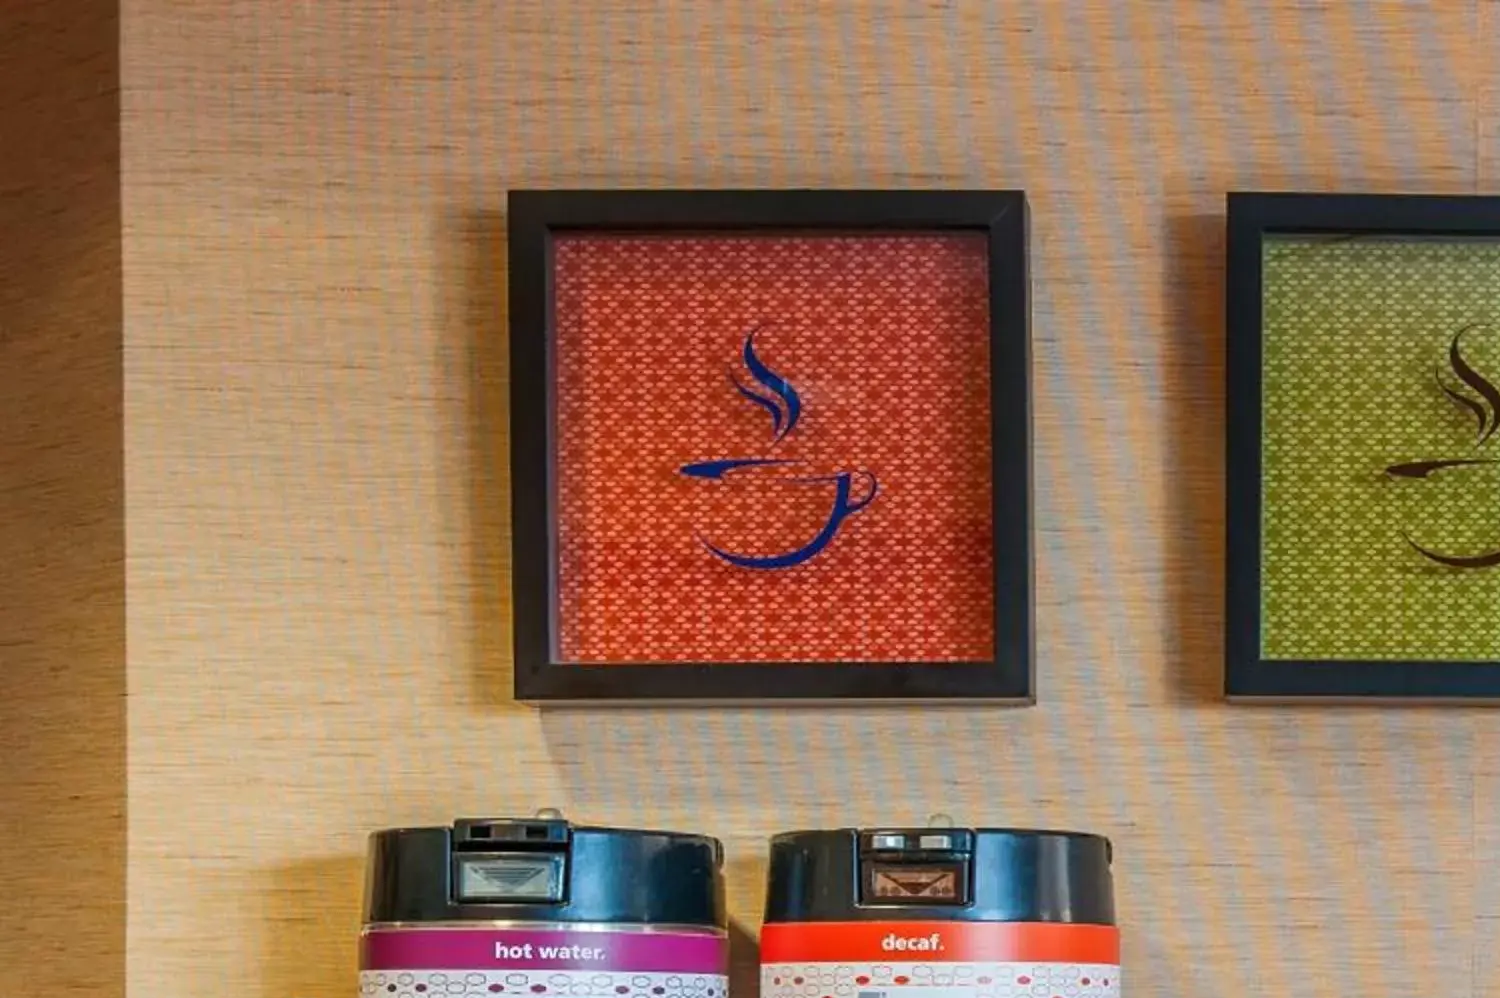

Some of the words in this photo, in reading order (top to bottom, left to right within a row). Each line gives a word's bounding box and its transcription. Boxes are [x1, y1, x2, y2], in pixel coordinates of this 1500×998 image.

[495, 941, 532, 959] hot
[539, 944, 606, 960] water.
[881, 933, 945, 951] decaf.
